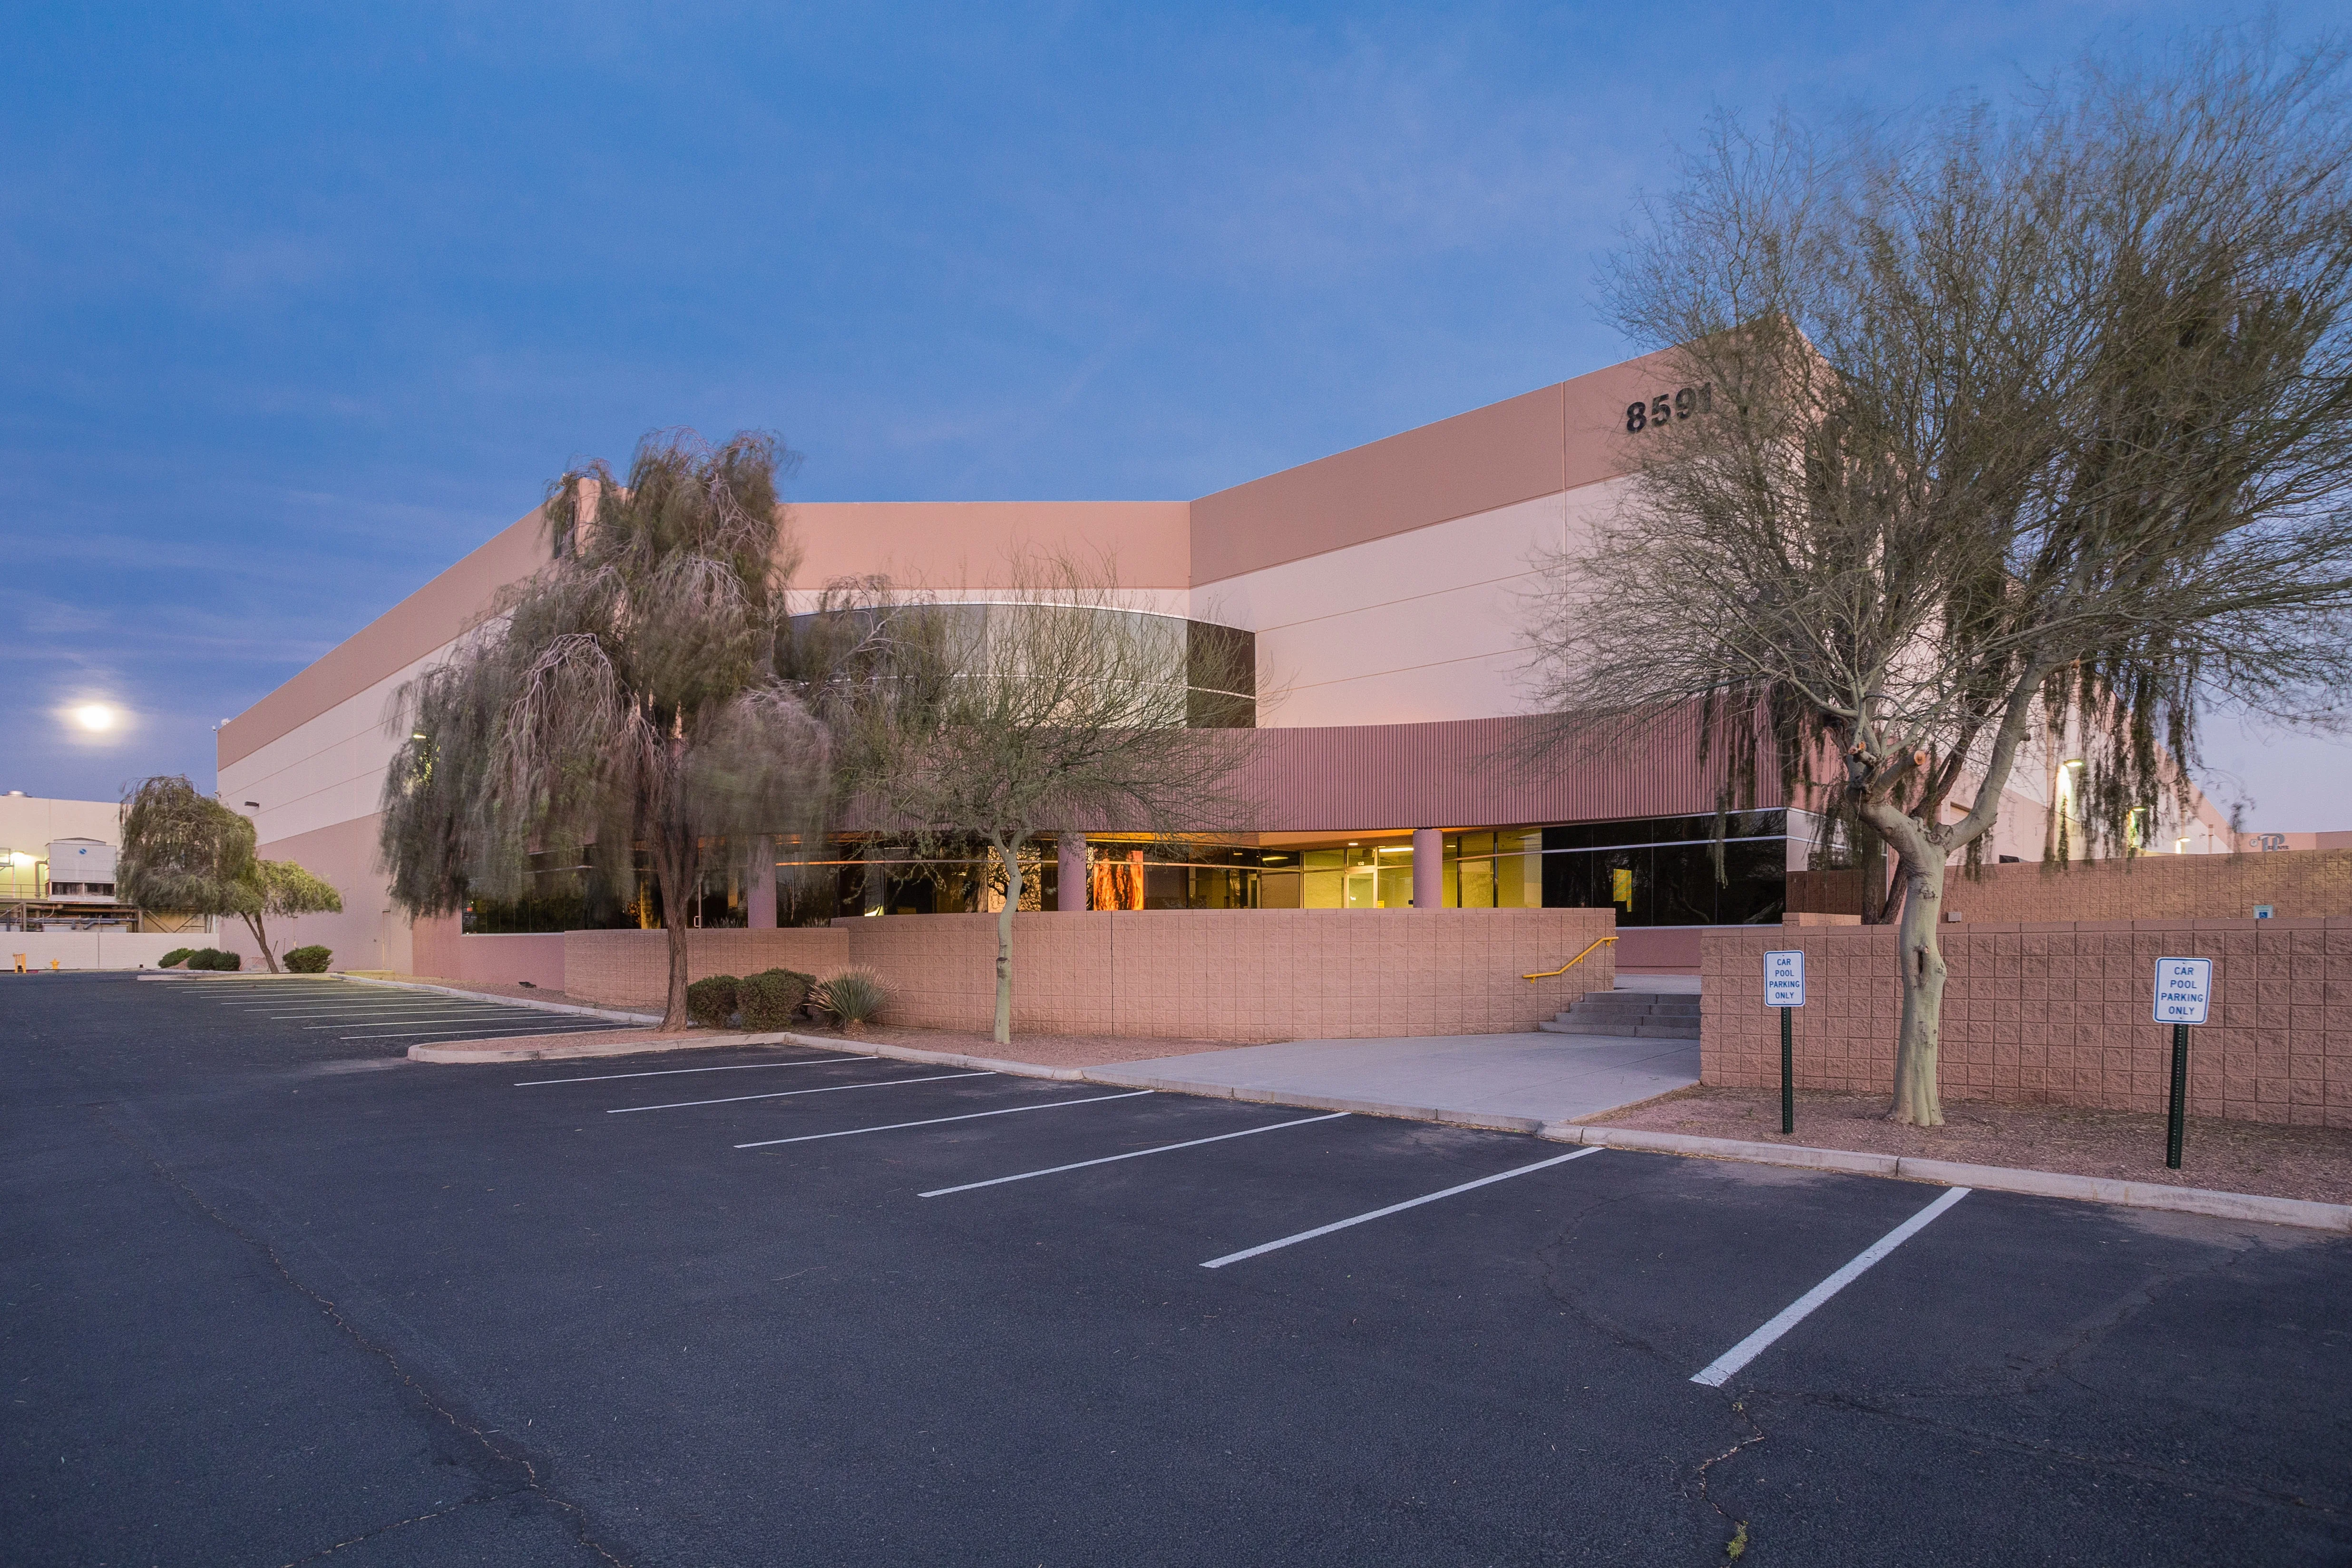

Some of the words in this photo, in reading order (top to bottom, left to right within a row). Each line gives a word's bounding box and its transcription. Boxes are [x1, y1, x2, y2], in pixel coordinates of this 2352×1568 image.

[1627, 382, 1711, 433] 8591
[2174, 967, 2194, 975] CAR
[2170, 980, 2197, 989] POOL
[2161, 993, 2203, 1002] PARKING
[2168, 1006, 2195, 1015] ONLY
